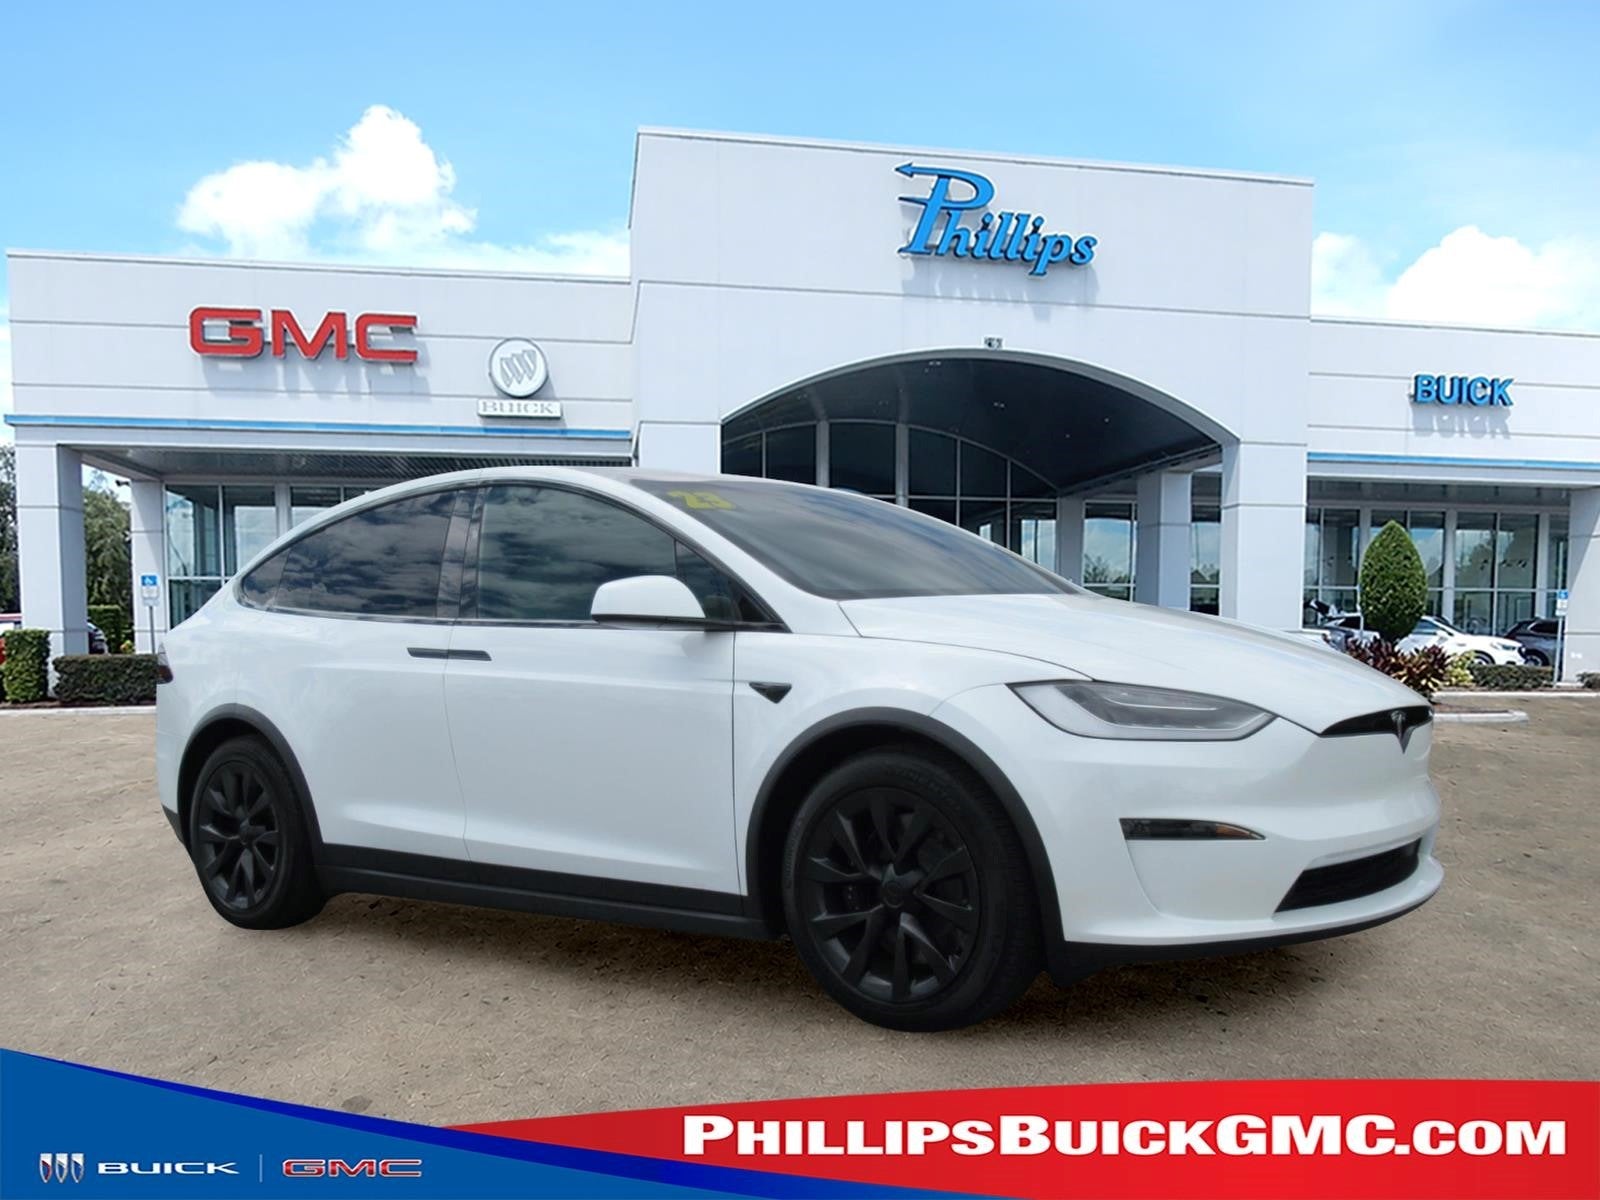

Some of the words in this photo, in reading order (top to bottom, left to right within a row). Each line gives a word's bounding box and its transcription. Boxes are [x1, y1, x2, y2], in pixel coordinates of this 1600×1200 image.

[895, 163, 1098, 276] Phillips
[189, 306, 418, 363] GMC
[482, 401, 554, 414] BUICK
[1413, 374, 1514, 406] BUICK
